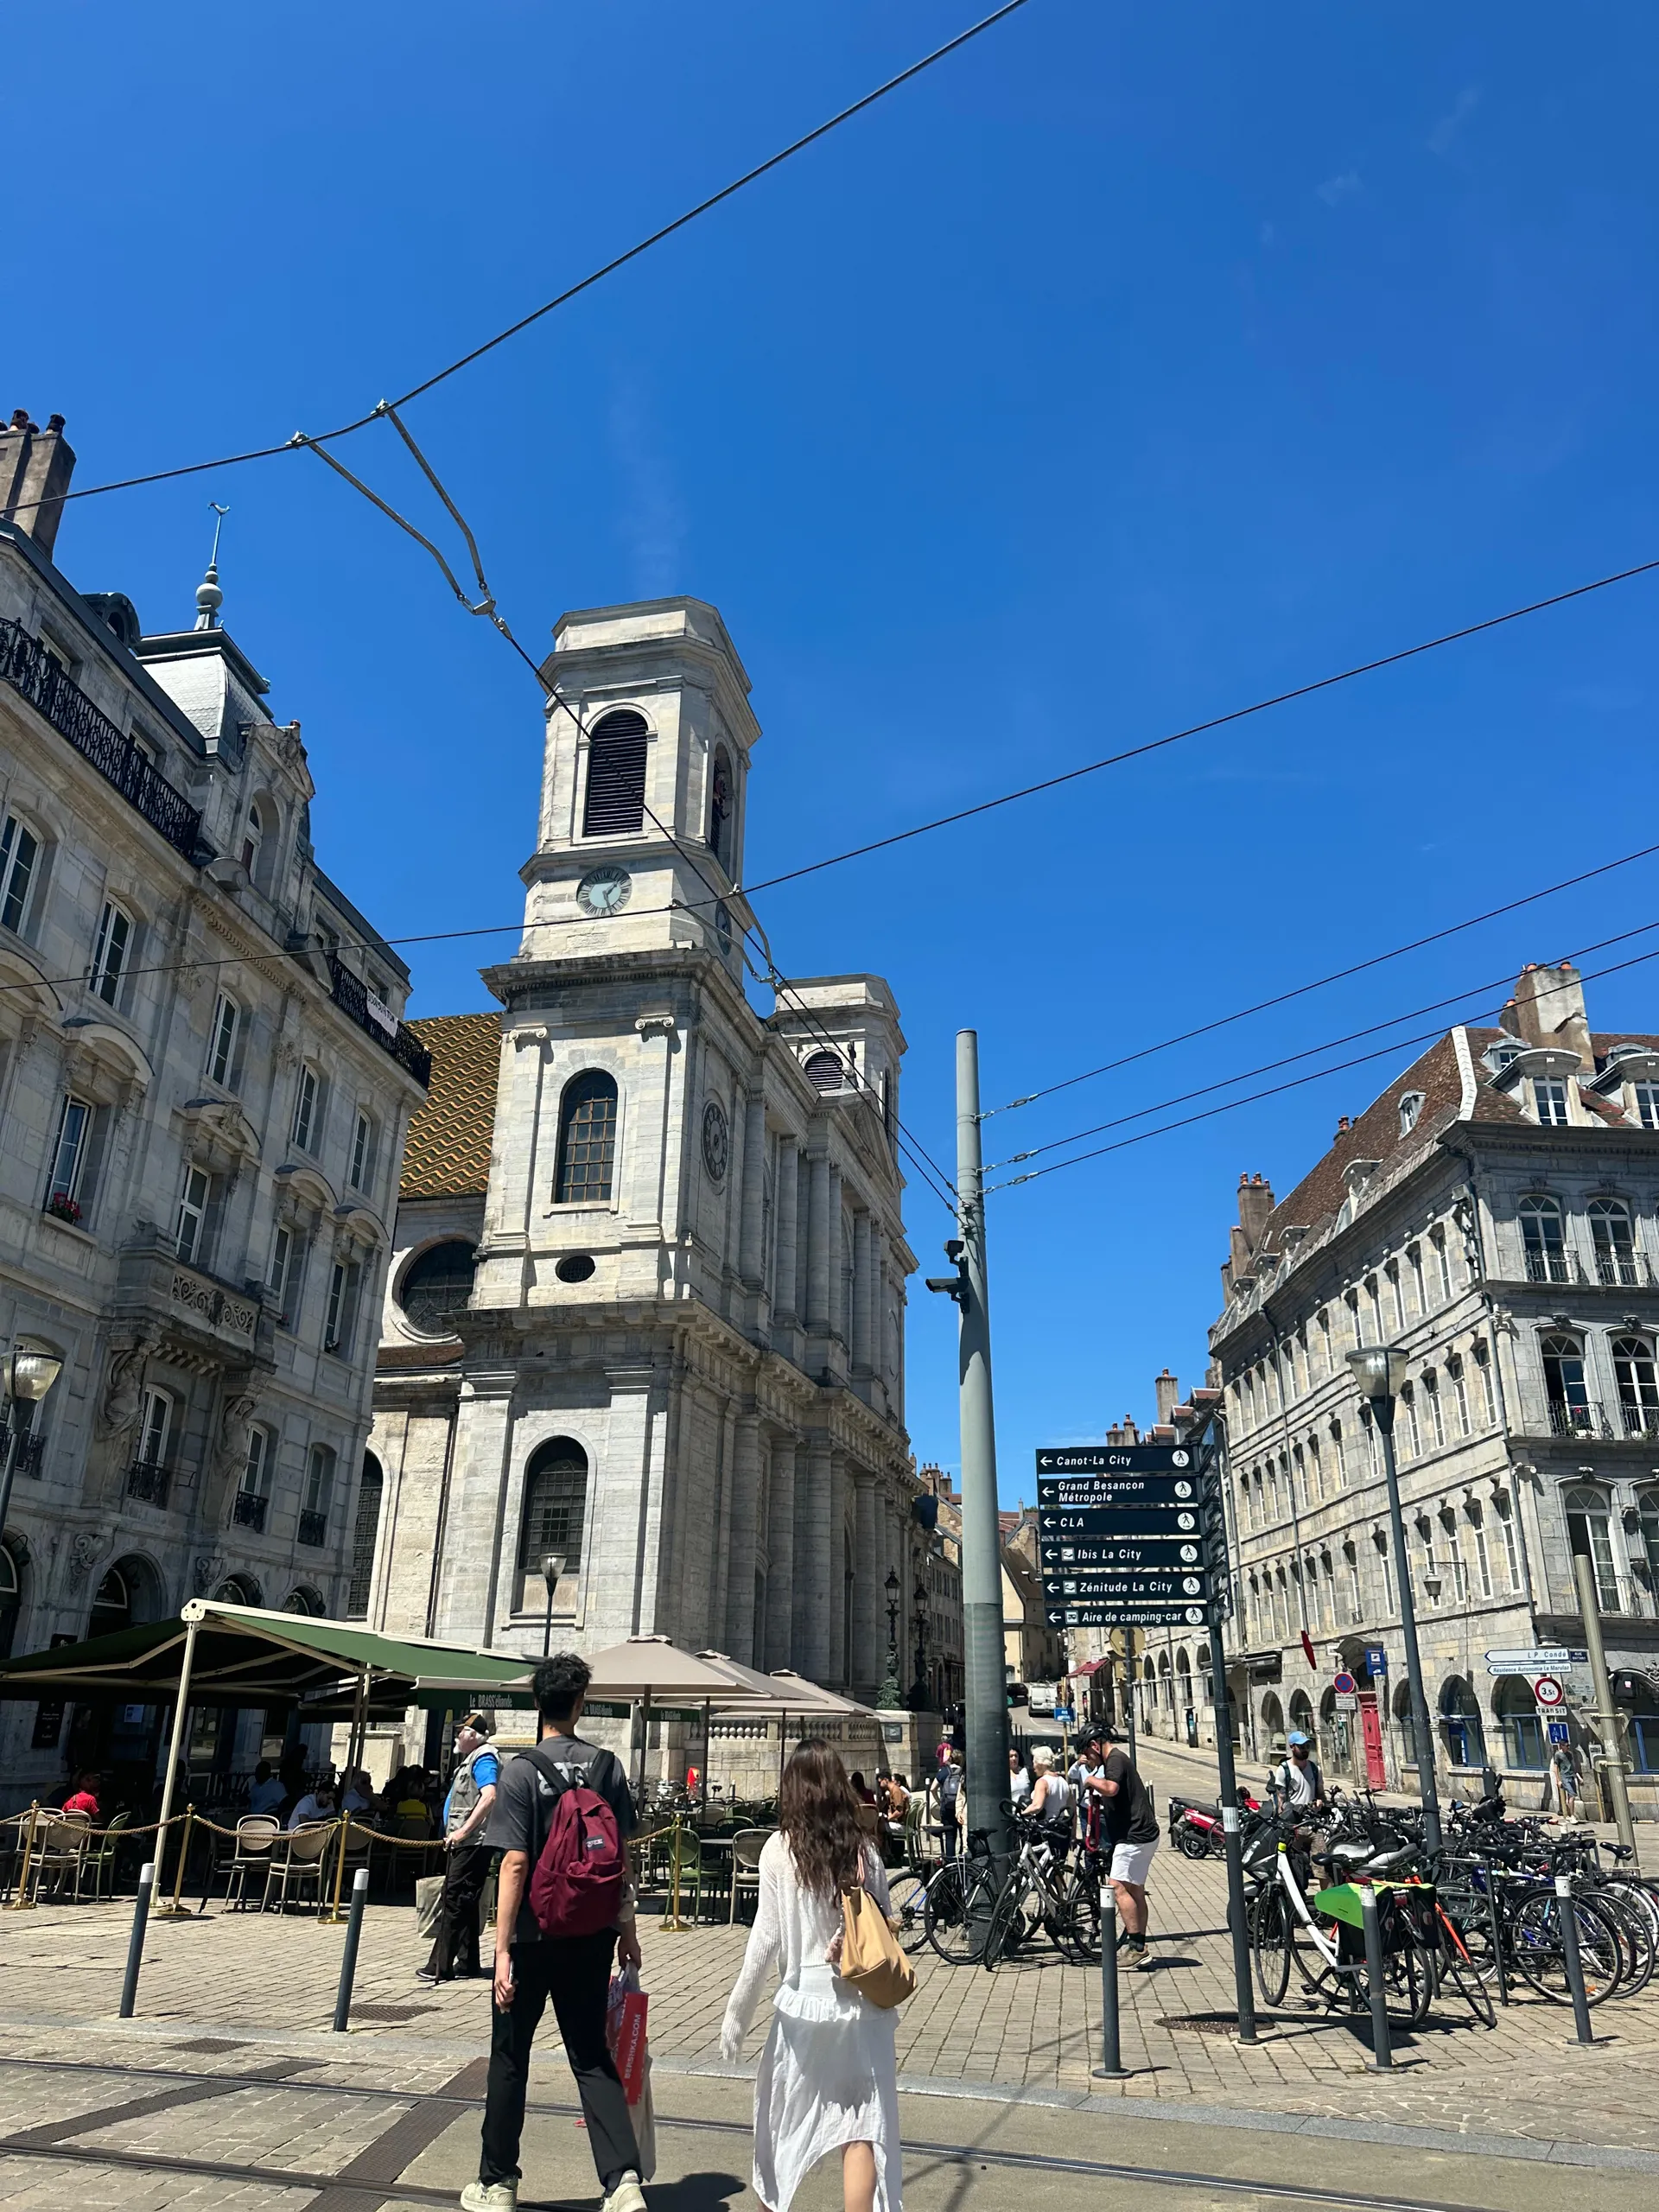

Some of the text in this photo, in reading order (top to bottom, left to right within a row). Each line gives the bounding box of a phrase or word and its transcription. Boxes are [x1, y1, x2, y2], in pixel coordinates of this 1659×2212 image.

[1056, 1455, 1131, 1466] Canot-La City
[1058, 1480, 1145, 1491] Grand Besançon
[1058, 1492, 1113, 1503] Métropole
[1060, 1517, 1084, 1528] CLA
[1077, 1549, 1141, 1560] Ibis La City
[1079, 1581, 1173, 1593] Zénitude La City
[1082, 1611, 1182, 1624] Aire de camping-car
[469, 1694, 476, 1708] Le
[624, 2013, 642, 2079] BERSHKA.COM
